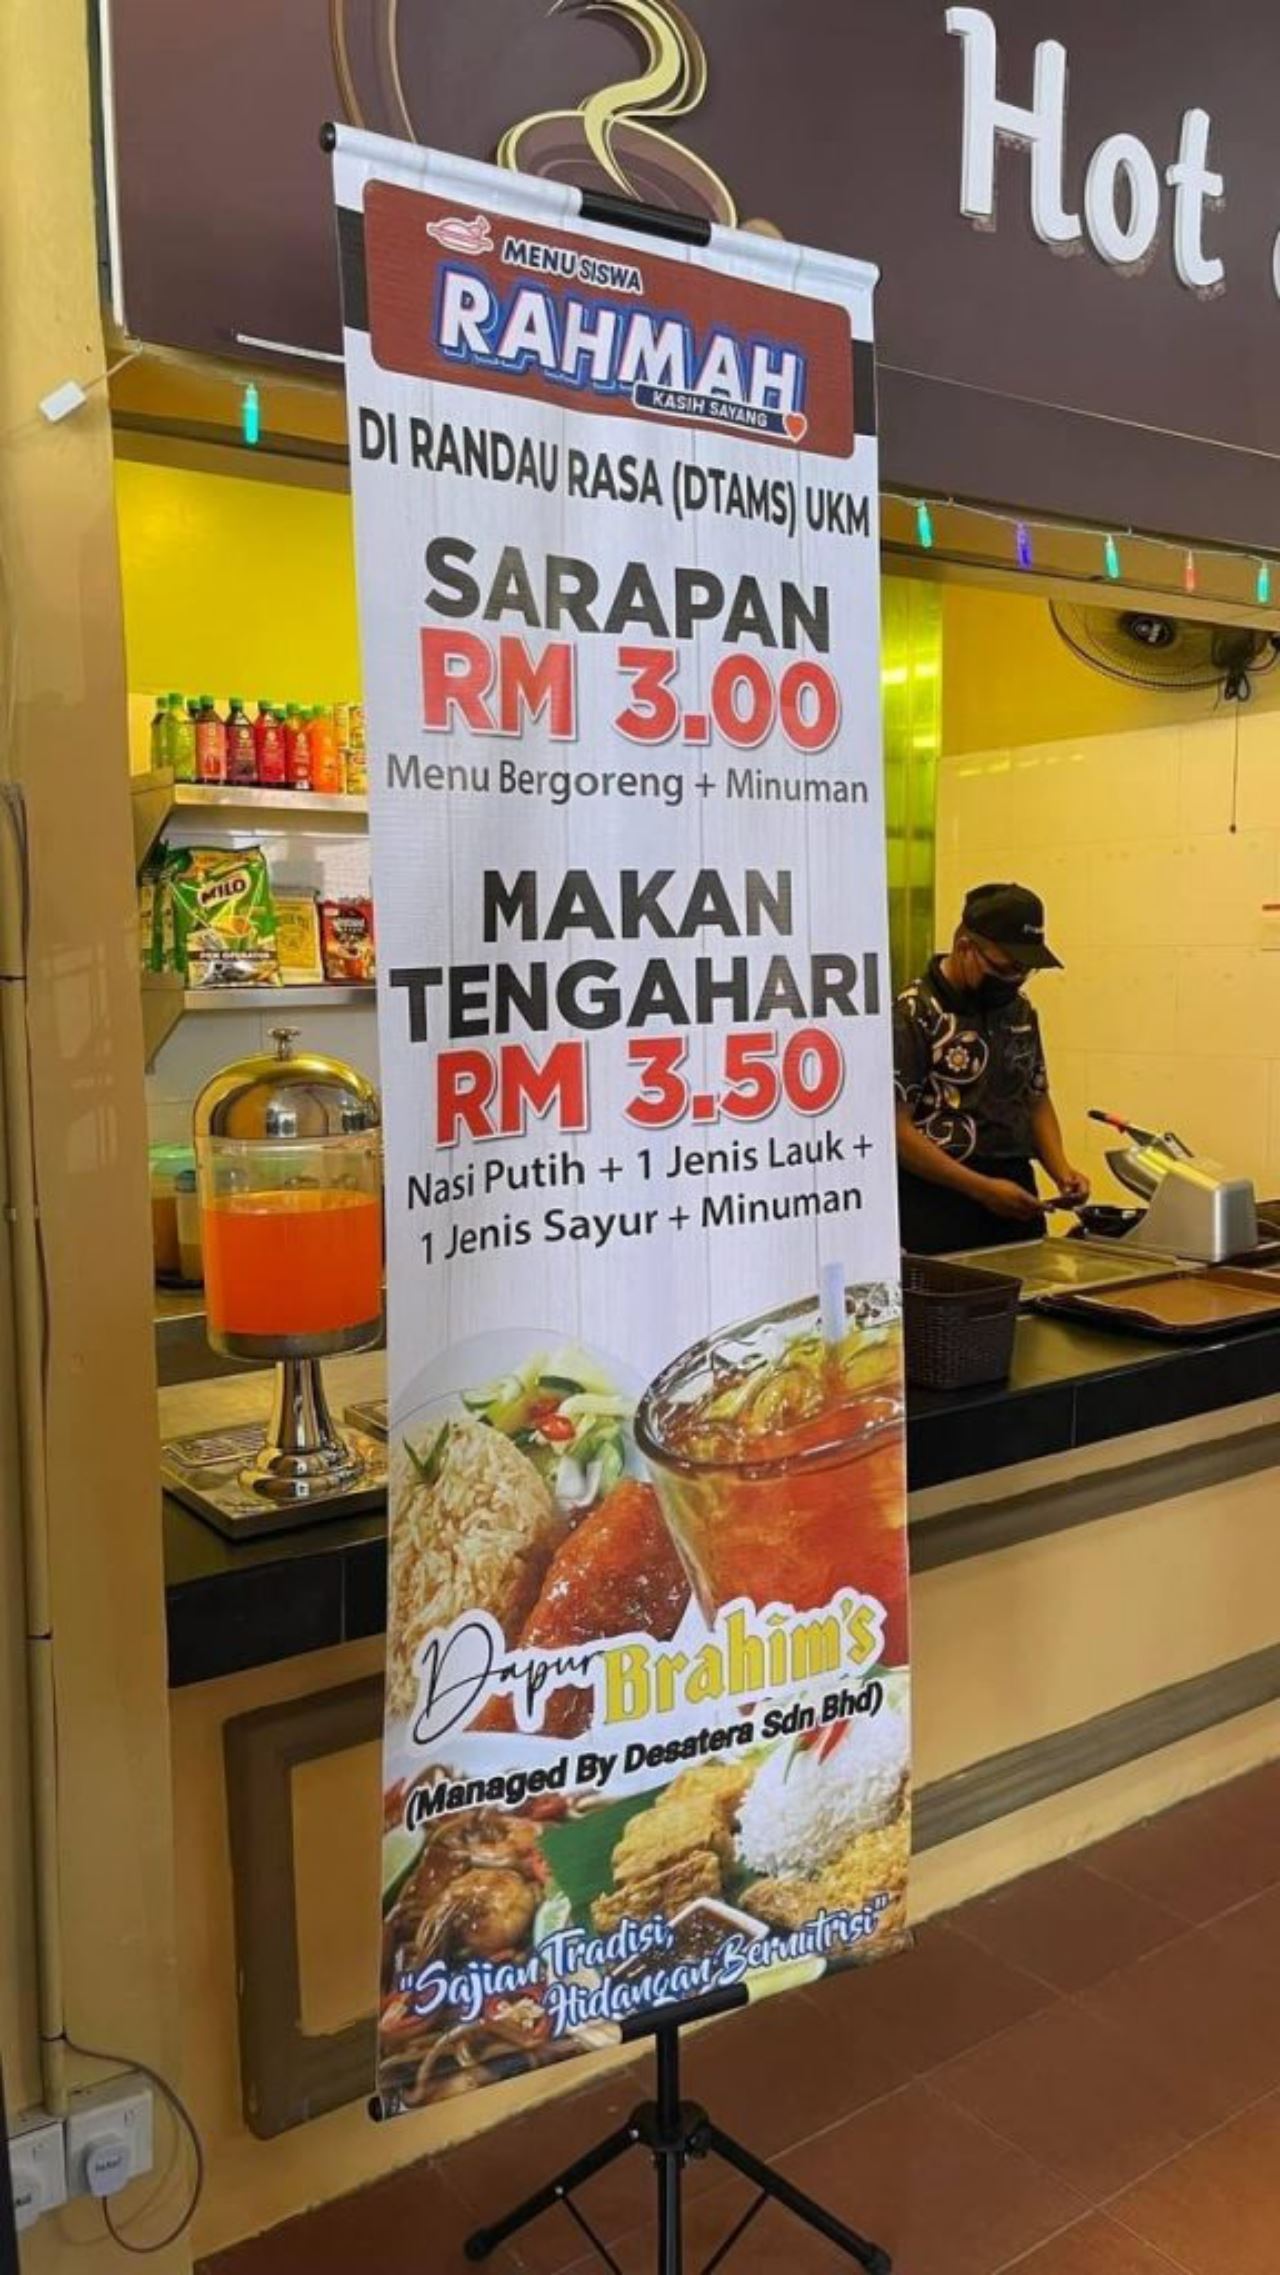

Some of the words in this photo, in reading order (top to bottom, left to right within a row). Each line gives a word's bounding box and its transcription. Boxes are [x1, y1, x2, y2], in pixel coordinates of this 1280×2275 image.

[945, 6, 1225, 287] Hot
[504, 239, 577, 275] MENU
[579, 259, 642, 294] SISWA
[438, 269, 804, 416] RAHMAH
[652, 392, 705, 414] KASIH
[709, 401, 768, 428] SAYANG
[359, 407, 397, 464] DI
[410, 425, 558, 492] RANDAU
[568, 449, 662, 507] RASA
[672, 461, 797, 537] (DTAMS)
[806, 487, 870, 537] UKM
[424, 536, 830, 653] SARAPAN
[420, 625, 577, 742] RM
[613, 644, 841, 755] 3.00
[386, 754, 490, 793] Menu
[499, 760, 684, 806] Bergoreng
[695, 774, 717, 798] +
[726, 768, 868, 804] Minuman
[201, 878, 246, 905] MILO
[483, 869, 793, 943] MAKAN
[390, 952, 880, 1043] TENGAHARI
[434, 1037, 589, 1149] RM
[624, 1027, 844, 1129] 3.50
[407, 1163, 474, 1210] Nasi
[485, 1152, 585, 1195] Putih
[600, 1158, 624, 1183] +
[637, 1149, 652, 1181] 1
[666, 1140, 758, 1180] Jenis
[769, 1130, 844, 1168] Lauk
[853, 1134, 874, 1158] +
[420, 1231, 434, 1266] 1
[444, 1214, 532, 1261] Jenis
[544, 1206, 659, 1248] Sayur
[668, 1206, 691, 1231] +
[700, 1185, 863, 1228] Minuman
[412, 1622, 606, 1746] Dapur
[603, 1597, 878, 1726] Brahim's
[404, 1759, 567, 1831] (Managed
[574, 1750, 614, 1788] By
[623, 1722, 754, 1774] Desatera
[761, 1702, 815, 1741] Sdn
[821, 1682, 884, 1725] Bhd)
[538, 1914, 676, 1979] Tradisi,
